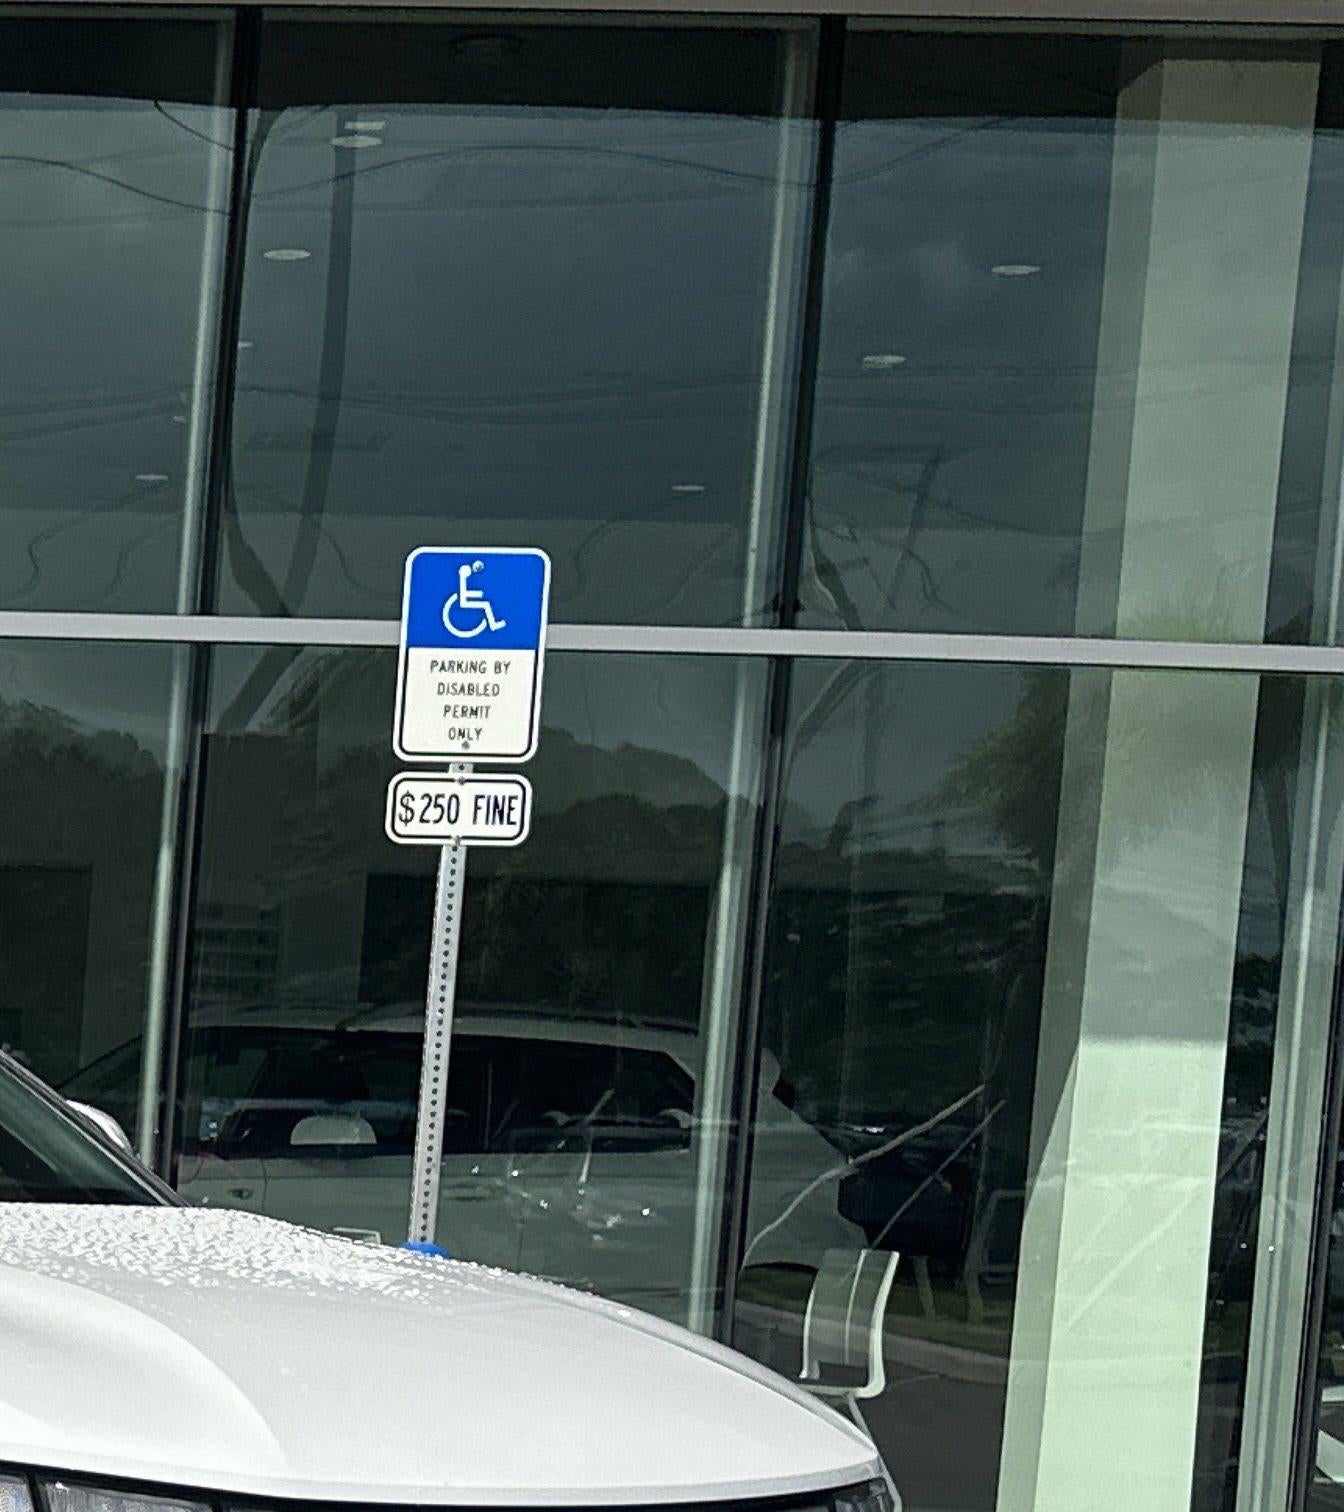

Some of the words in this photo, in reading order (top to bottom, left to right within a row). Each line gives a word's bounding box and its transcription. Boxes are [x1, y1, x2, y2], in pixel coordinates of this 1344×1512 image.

[430, 660, 487, 675] PARKING
[494, 661, 511, 675] BY
[437, 682, 500, 697] DISABLED
[443, 705, 491, 720] PERMIT
[448, 727, 483, 742] ONLY
[398, 790, 460, 826] $250
[472, 794, 519, 826] FINE
